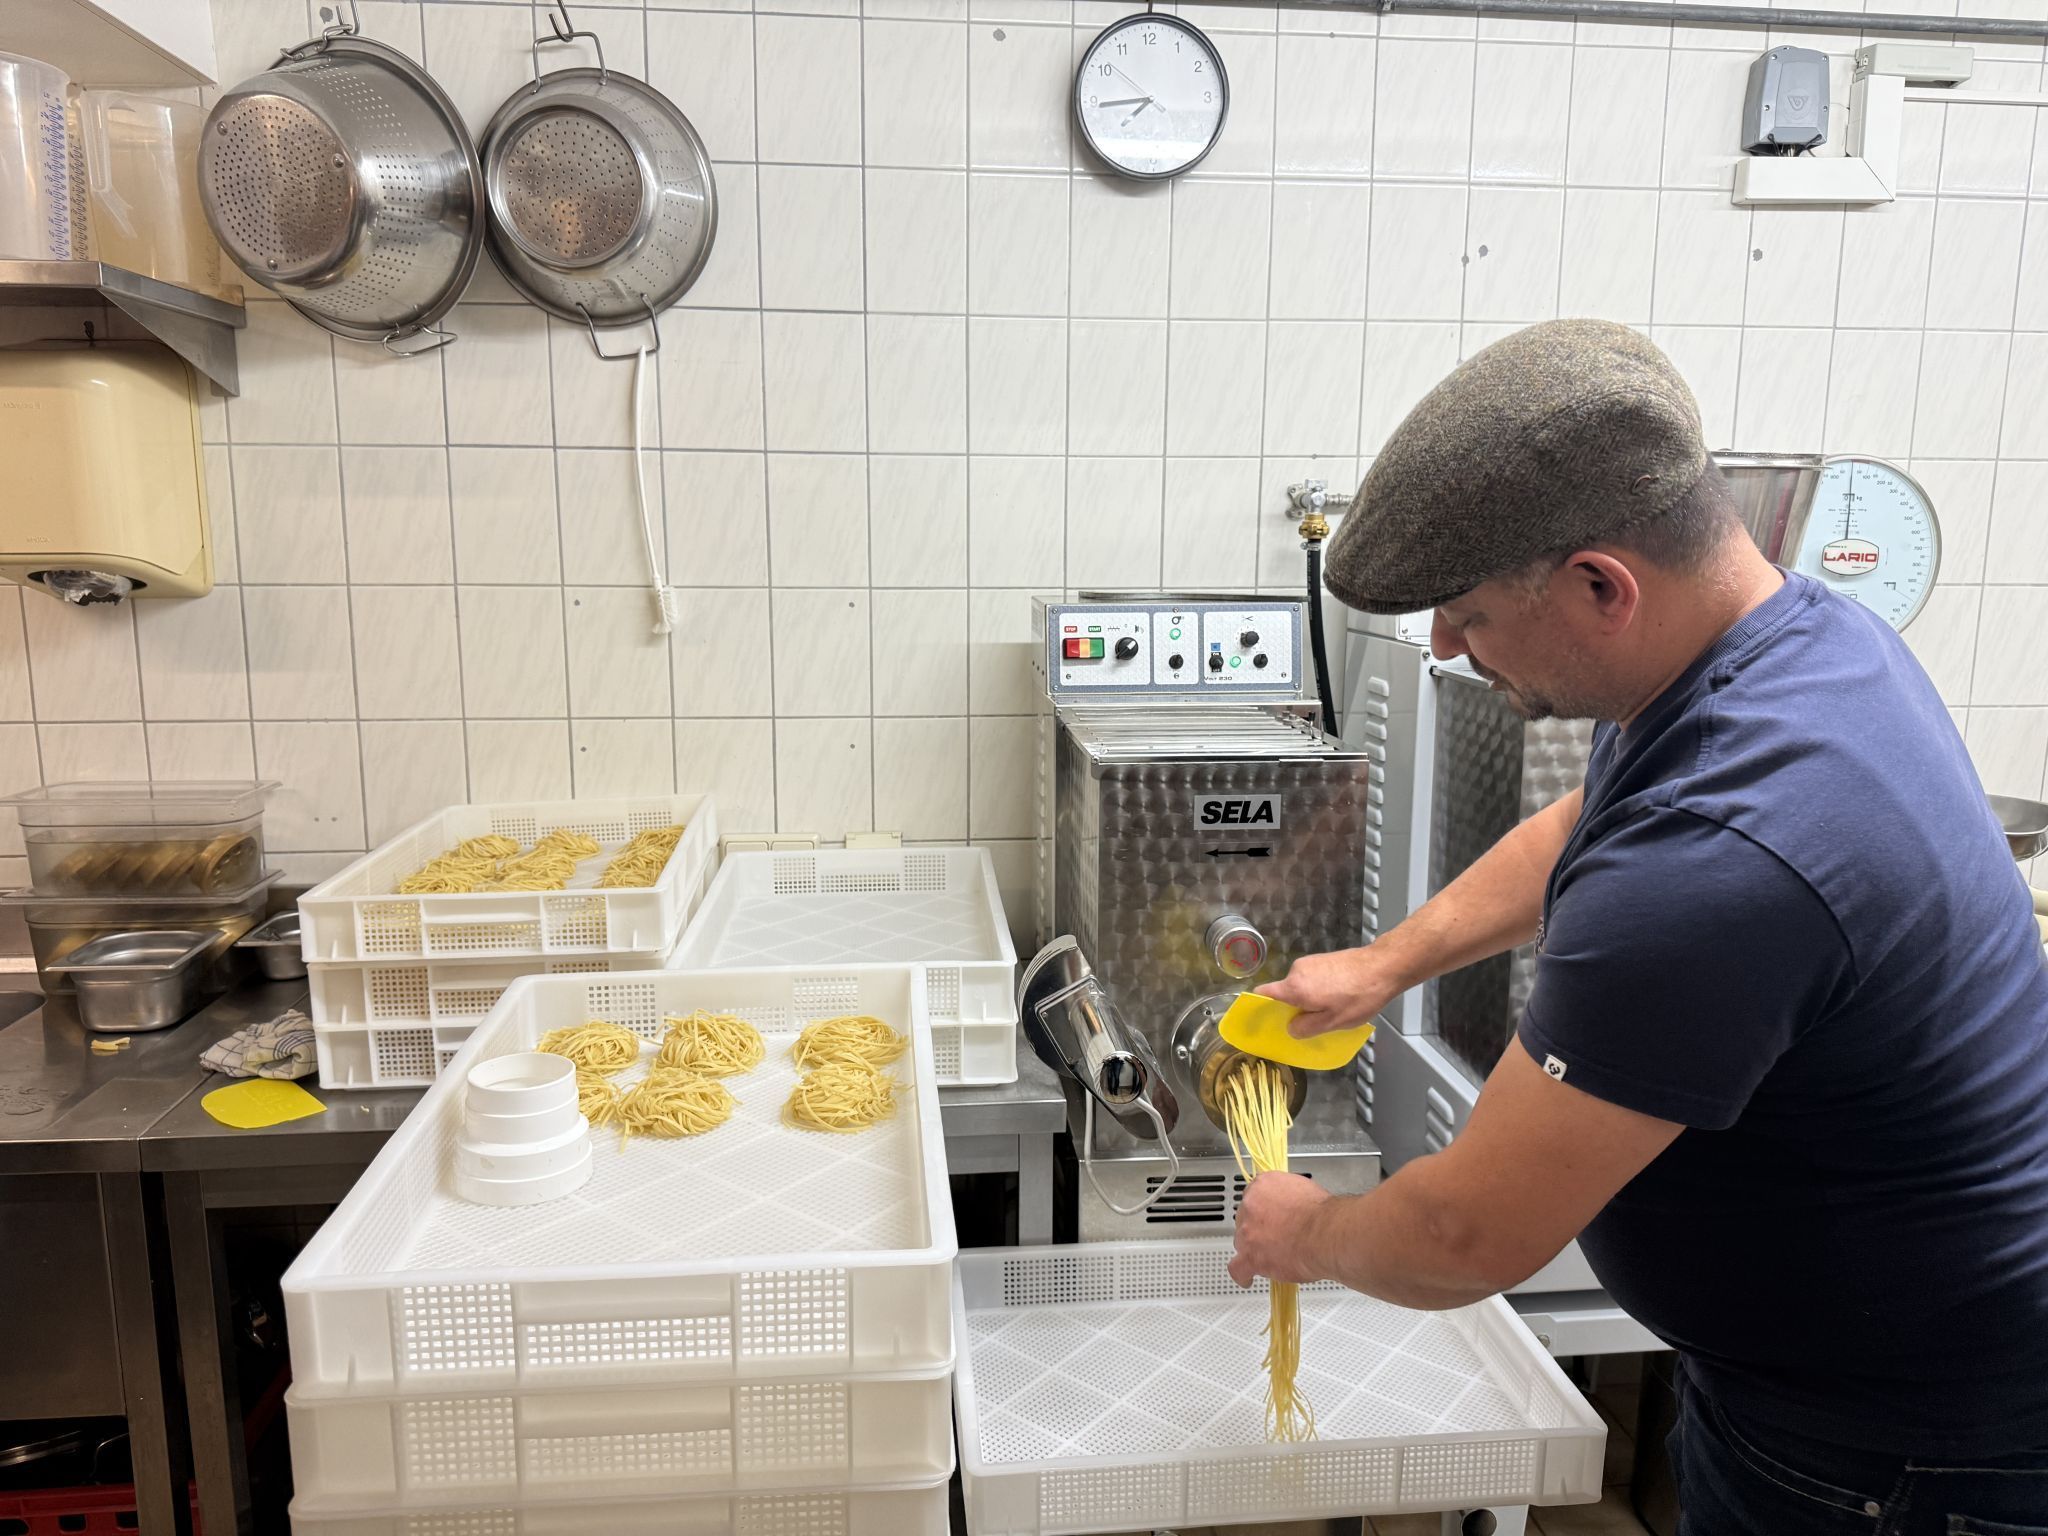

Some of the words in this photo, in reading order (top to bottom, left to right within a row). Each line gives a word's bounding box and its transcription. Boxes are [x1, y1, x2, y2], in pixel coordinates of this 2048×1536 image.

[1142, 33, 1156, 45] 12
[1117, 44, 1128, 56] 11
[1175, 42, 1180, 54] 1
[1098, 64, 1112, 77] 10
[1194, 61, 1202, 73] 2
[1090, 96, 1098, 108] 9
[1204, 91, 1212, 104] 3
[1823, 552, 1878, 563] LARIO
[1200, 800, 1274, 825] SELA
